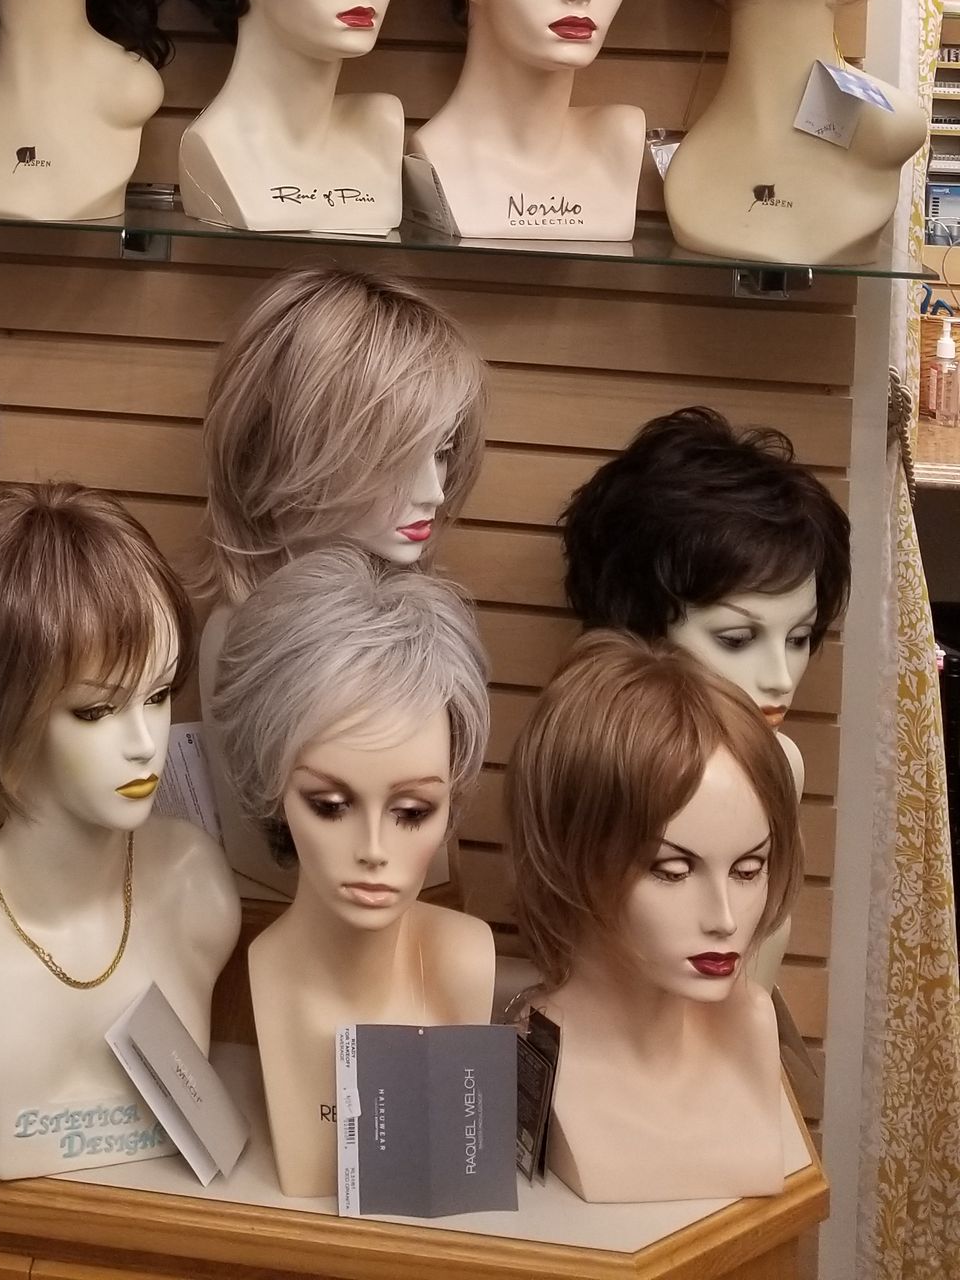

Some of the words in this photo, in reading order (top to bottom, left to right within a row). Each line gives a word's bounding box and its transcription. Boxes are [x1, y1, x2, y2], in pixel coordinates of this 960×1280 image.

[322, 190, 335, 207] of
[334, 188, 376, 205] Paris
[508, 192, 582, 218] Noriko
[509, 218, 585, 226] COLLECTION
[464, 1068, 476, 1118] WELCH
[378, 1088, 386, 1151] HAIRUWEAR
[465, 1119, 476, 1175] RAQUEL
